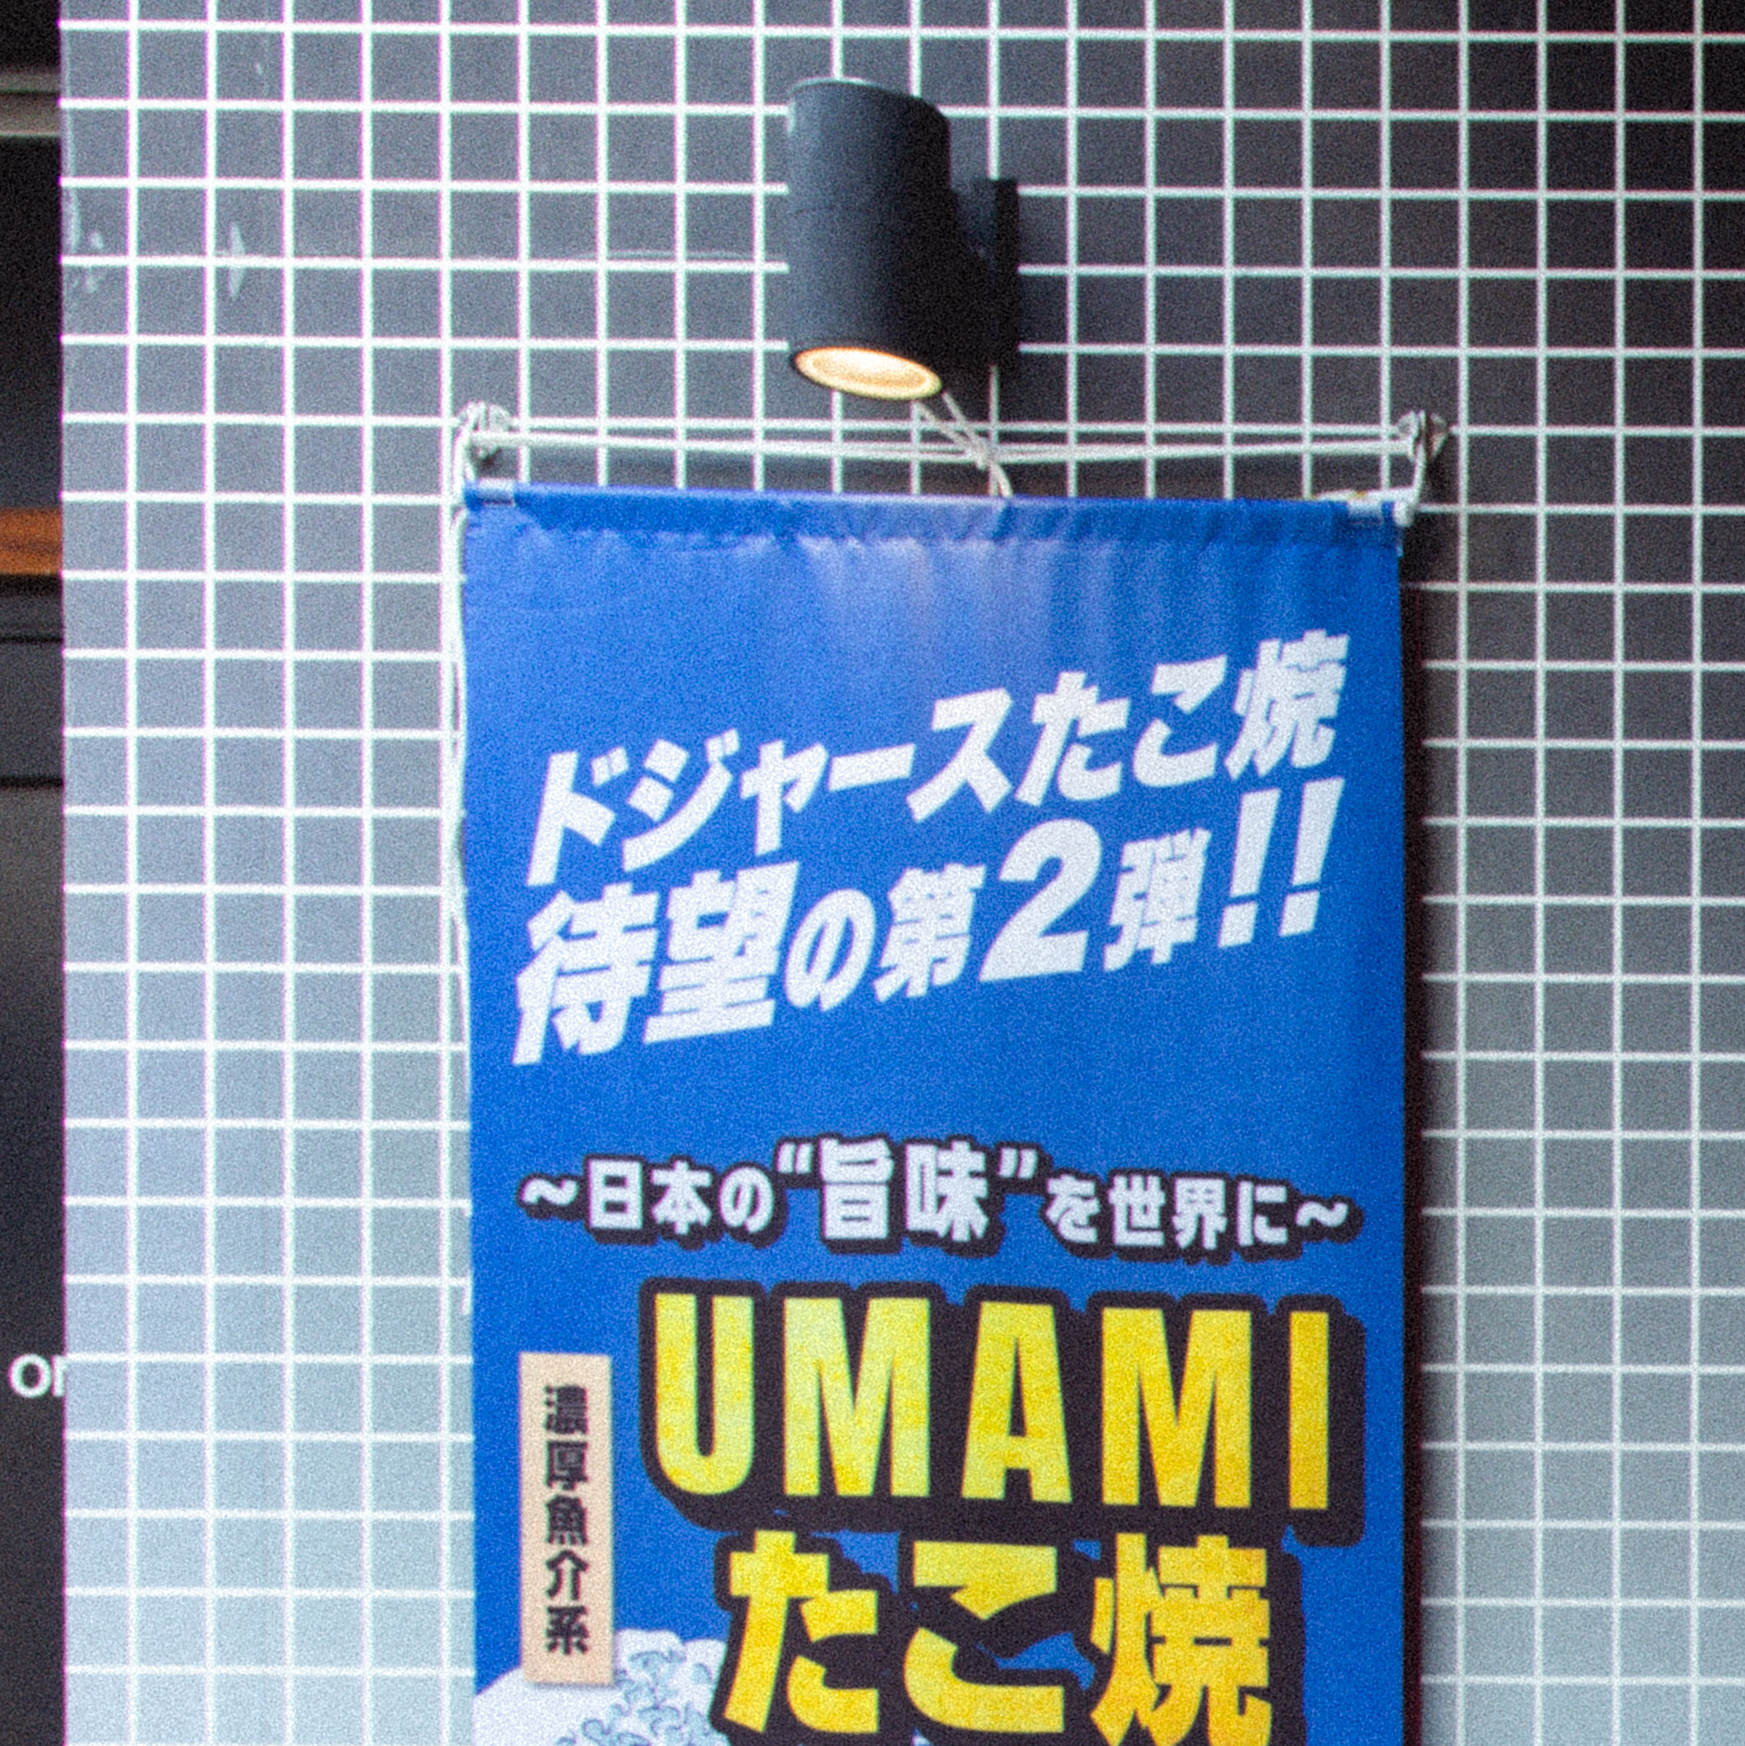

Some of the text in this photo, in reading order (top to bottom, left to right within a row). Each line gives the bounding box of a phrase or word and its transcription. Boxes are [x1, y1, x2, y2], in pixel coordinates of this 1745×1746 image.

[526, 629, 1349, 886] ドジャースたこ焼
[511, 776, 1344, 1066] 待望の第2弾!!
[544, 1384, 591, 1656] 濃厚魚介系
[653, 1292, 1331, 1511] UMAMI
